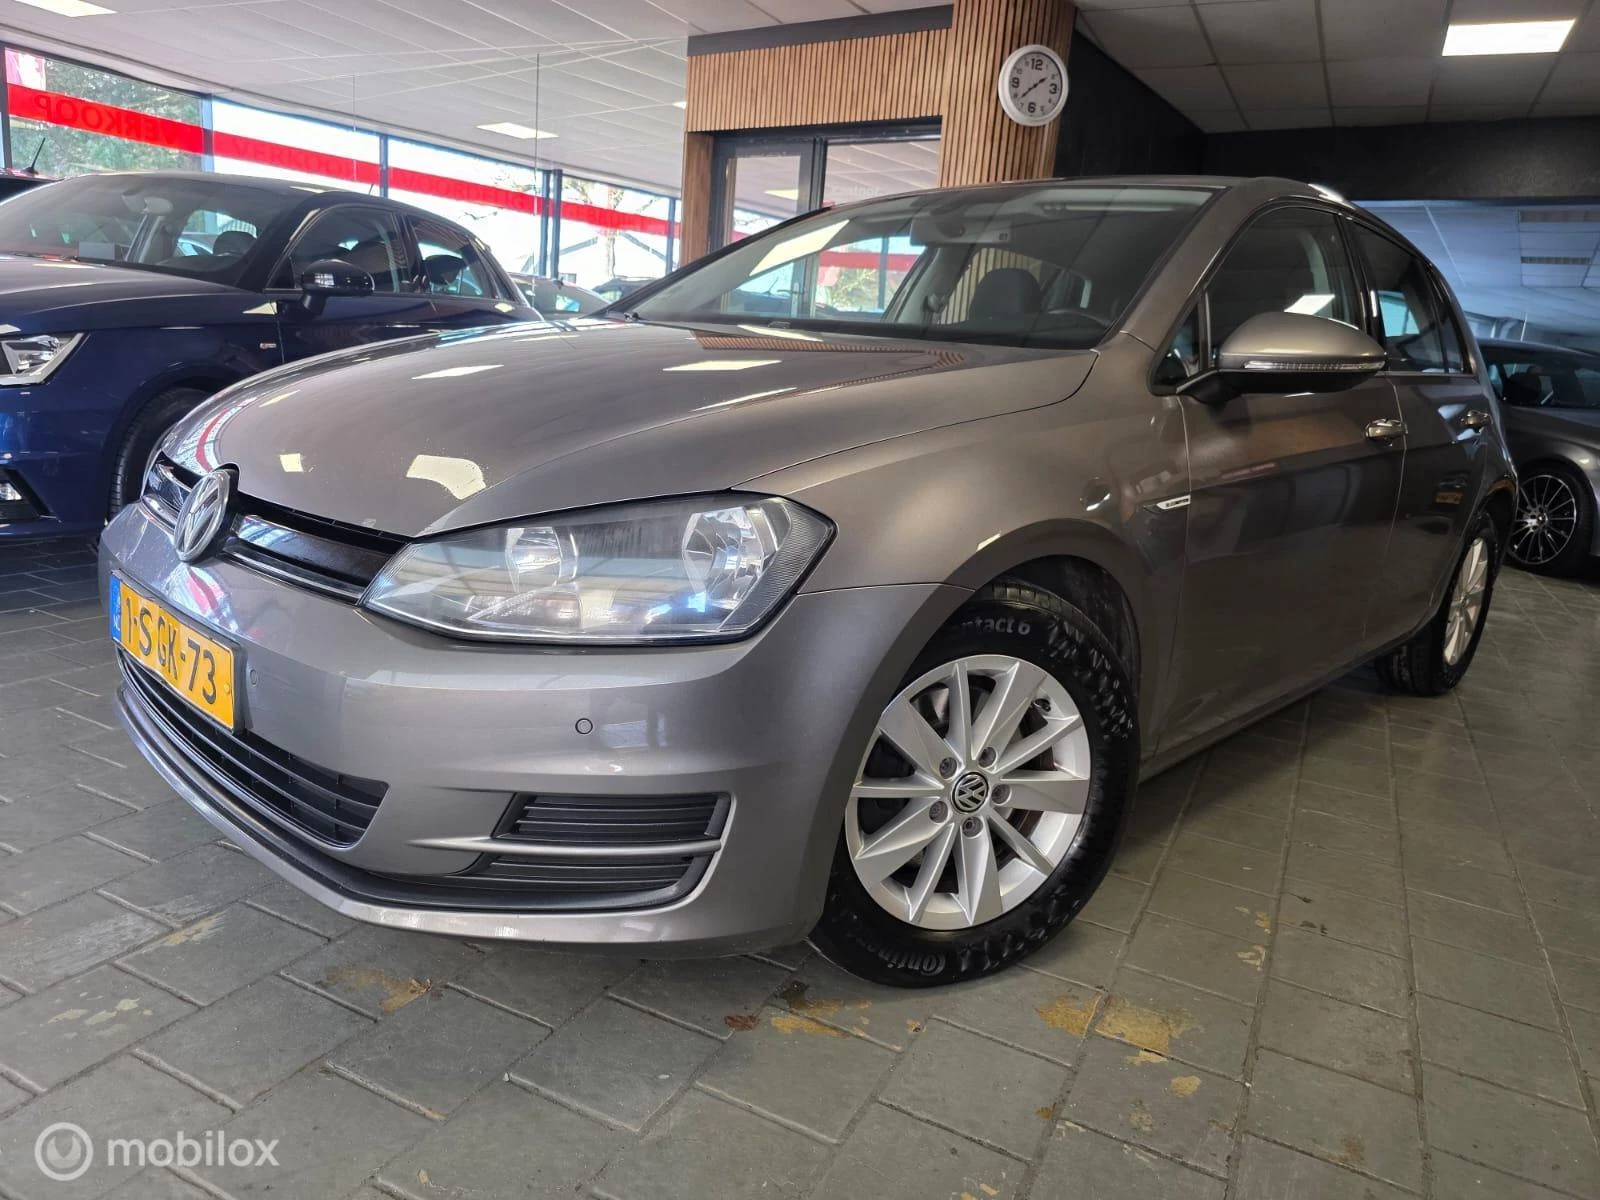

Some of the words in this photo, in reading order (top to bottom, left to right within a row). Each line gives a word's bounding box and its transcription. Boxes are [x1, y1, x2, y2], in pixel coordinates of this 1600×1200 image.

[1031, 58, 1043, 71] 12
[1011, 77, 1020, 89] 9
[1049, 83, 1058, 94] 3
[1027, 101, 1037, 113] 6
[126, 597, 217, 704] 1-SGK-73
